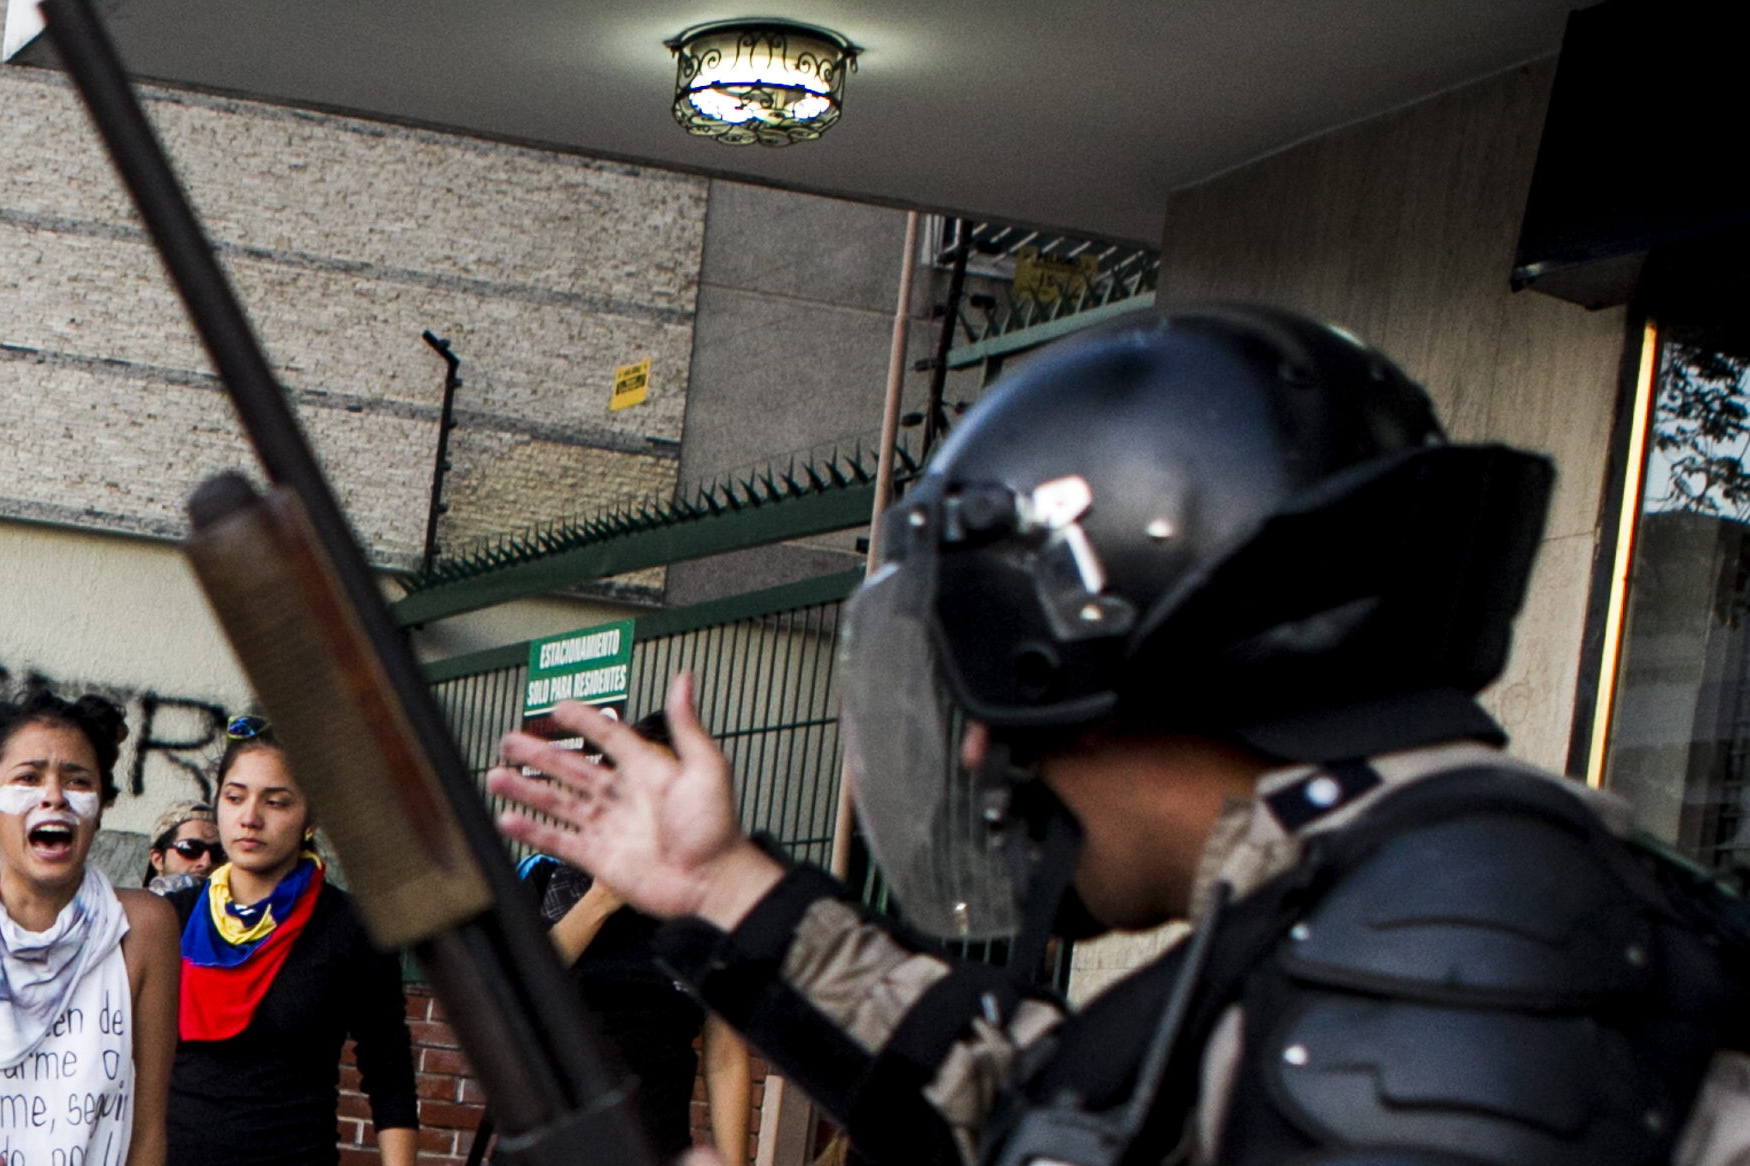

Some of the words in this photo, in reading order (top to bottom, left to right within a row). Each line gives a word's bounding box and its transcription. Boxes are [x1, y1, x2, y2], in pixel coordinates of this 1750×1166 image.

[539, 628, 620, 670] ESTACIONAMIENTO
[526, 678, 550, 706] SOLO
[573, 663, 628, 699] RESIDENTES
[99, 989, 125, 1036] de
